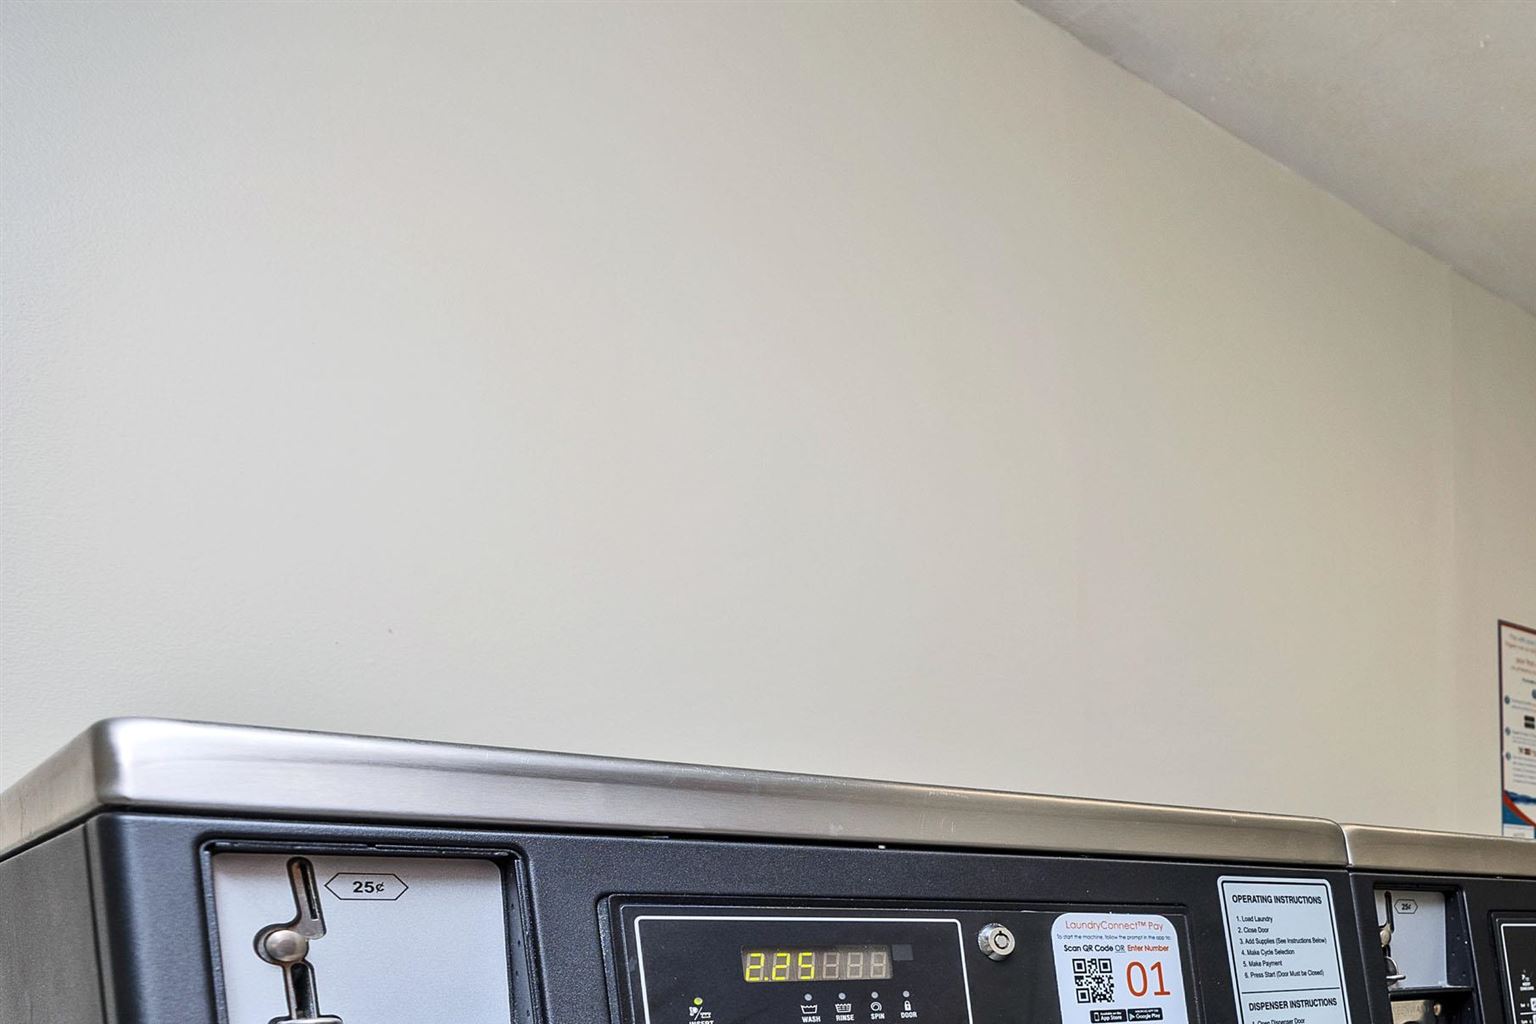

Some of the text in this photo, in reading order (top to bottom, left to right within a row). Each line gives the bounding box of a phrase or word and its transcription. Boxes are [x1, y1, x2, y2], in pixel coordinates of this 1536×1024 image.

[352, 881, 385, 893] 25¢
[1232, 895, 1322, 904] OPERATING INSTRUCTIONS
[1149, 922, 1163, 931] Pay
[1127, 962, 1170, 997] 01
[1249, 998, 1337, 1011] DISPENSER INSTRUCTIONS
